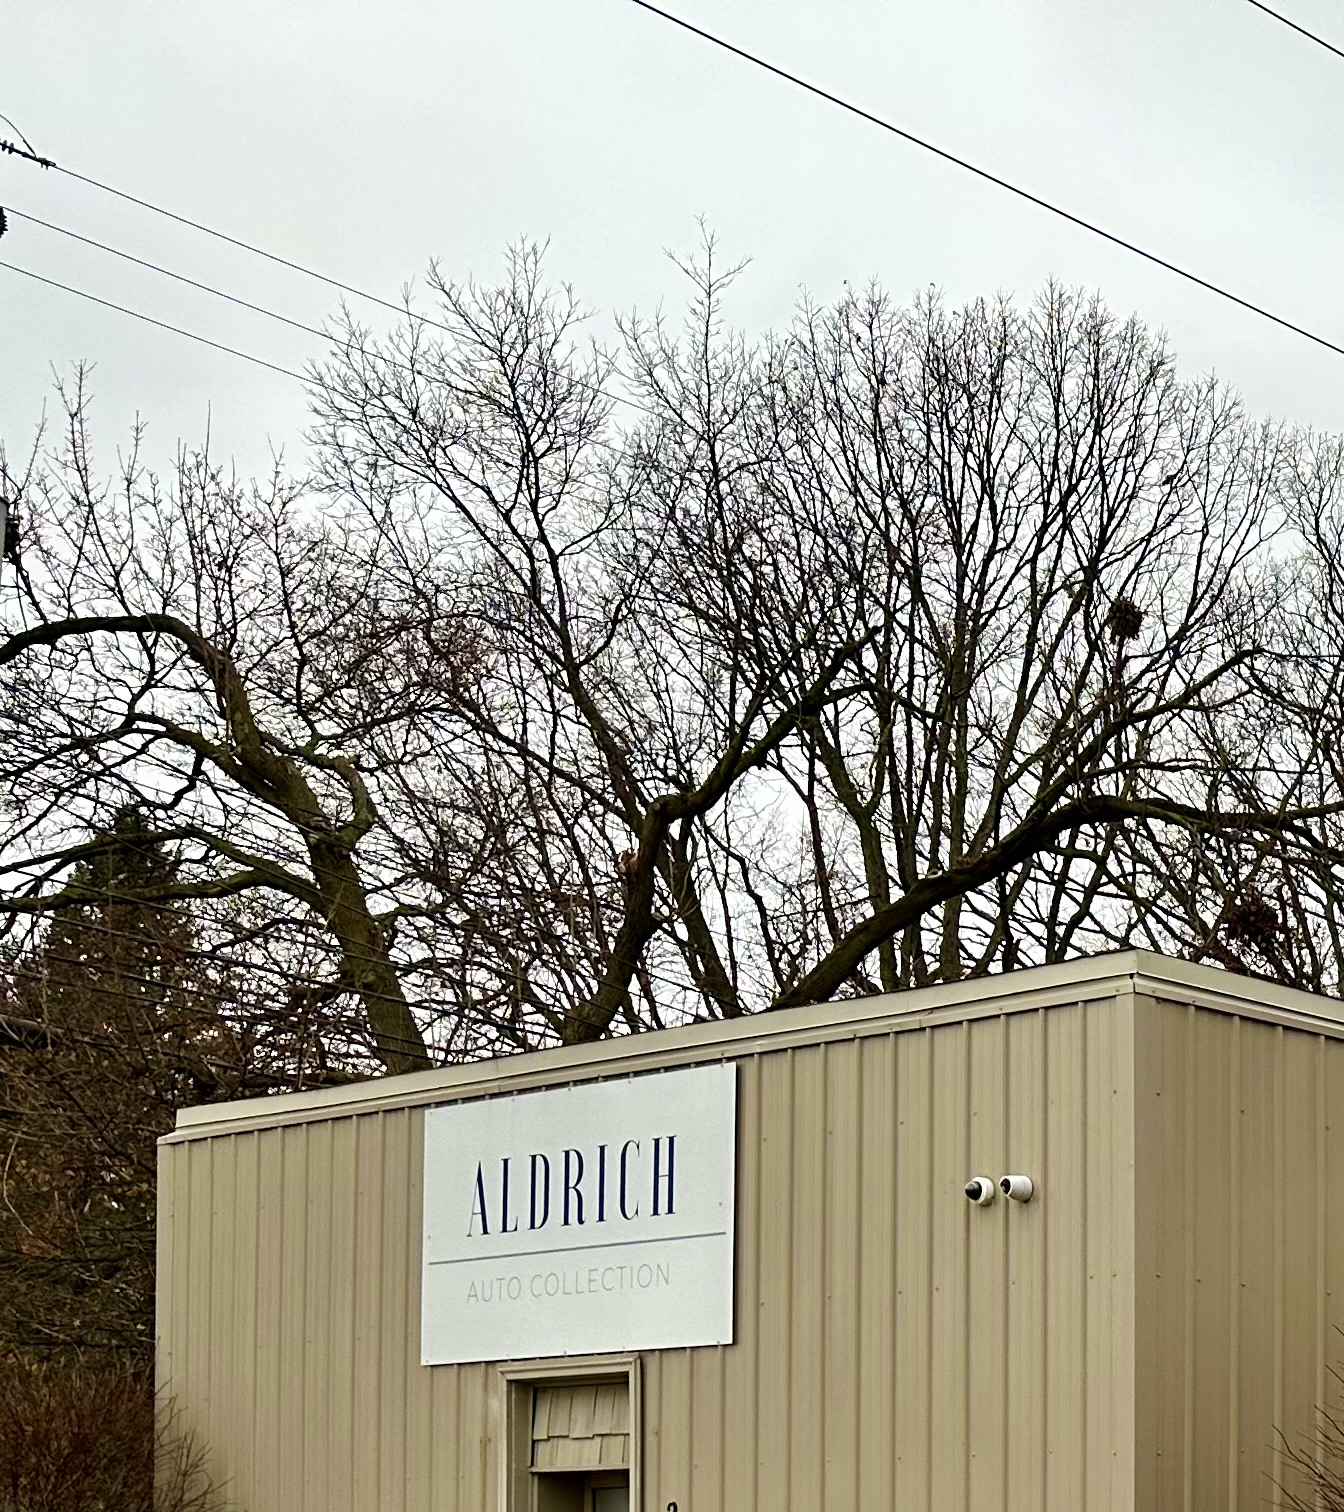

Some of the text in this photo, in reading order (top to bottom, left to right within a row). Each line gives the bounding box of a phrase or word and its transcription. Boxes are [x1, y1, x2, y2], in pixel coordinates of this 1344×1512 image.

[466, 1135, 678, 1238] ALDRICH
[466, 1262, 671, 1304] AUTO COLLECTION
